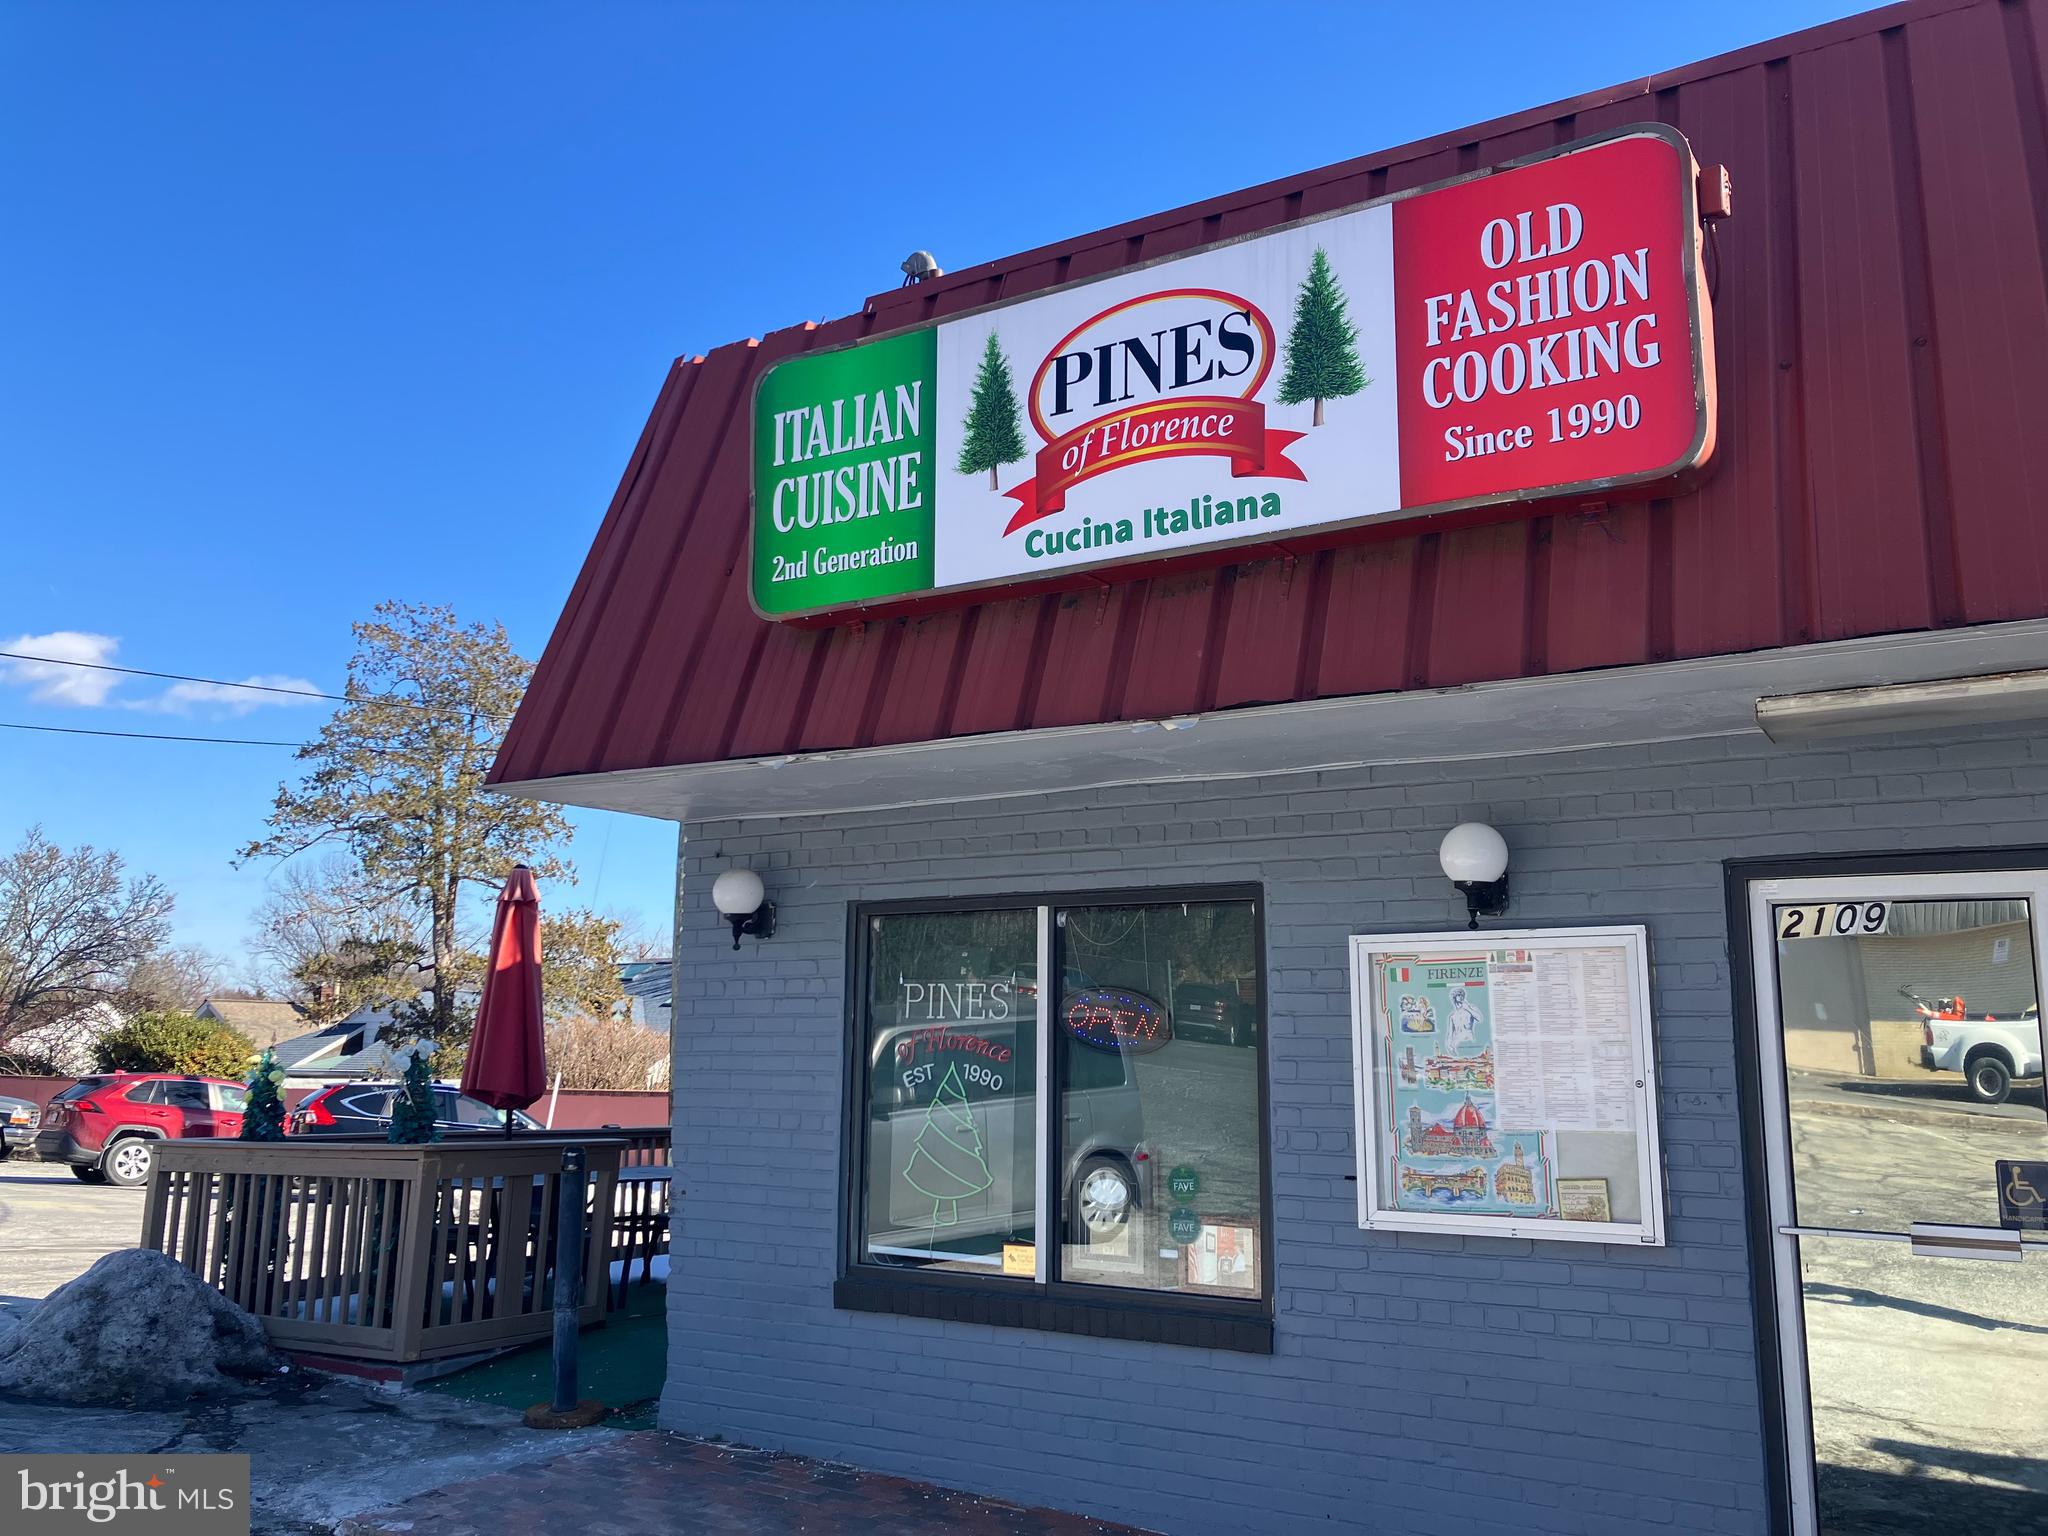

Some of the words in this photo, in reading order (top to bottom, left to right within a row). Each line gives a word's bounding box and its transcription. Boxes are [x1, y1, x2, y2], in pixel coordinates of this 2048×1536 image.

[1480, 203, 1584, 270] OLD
[1424, 248, 1650, 348] FASHION
[1050, 309, 1255, 417] PINES
[1422, 313, 1661, 409] COOKING
[773, 380, 922, 467] ITALIAN
[1062, 428, 1095, 477] of
[1098, 413, 1235, 458] Florence
[1444, 424, 1534, 463] Since
[1547, 394, 1642, 444] 1990
[772, 451, 922, 533] CUISINE
[1025, 516, 1134, 558] Cucina
[1143, 492, 1281, 539] Italiana
[771, 550, 808, 582] 2nd
[813, 536, 919, 576] Generation
[1782, 902, 1886, 939] 2109
[903, 982, 1009, 1020] PINES
[1427, 967, 1484, 980] FIRENZE
[1069, 1003, 1160, 1041] OPEN
[902, 1063, 935, 1088] EST
[963, 1063, 1003, 1091] 1990
[1172, 1181, 1195, 1193] FAVE
[1172, 1222, 1195, 1233] FAVE
